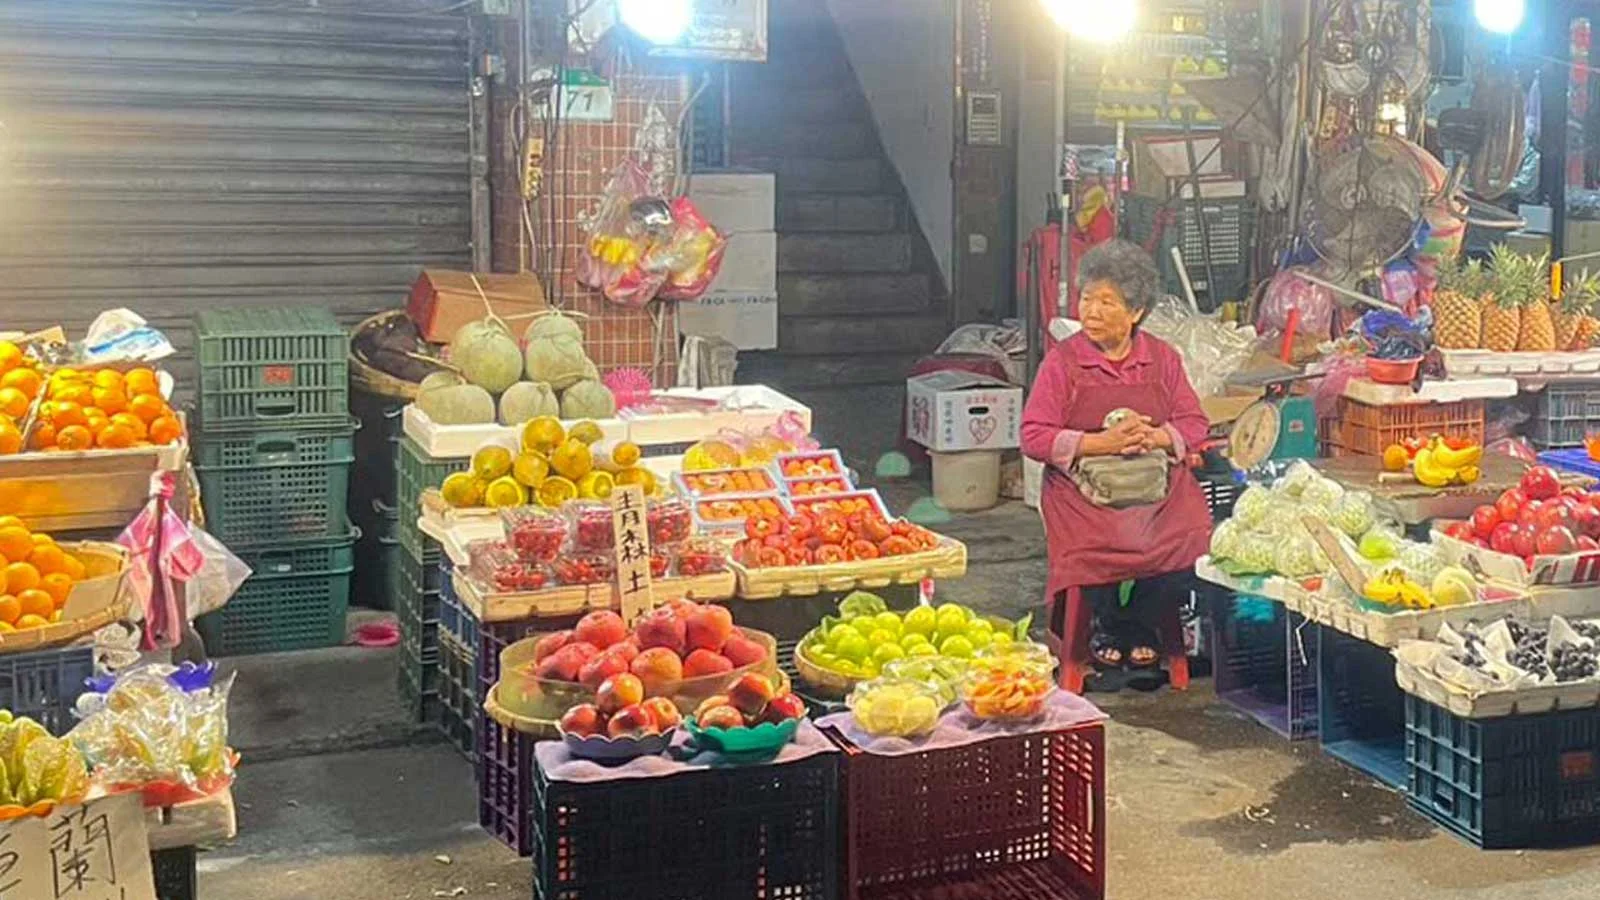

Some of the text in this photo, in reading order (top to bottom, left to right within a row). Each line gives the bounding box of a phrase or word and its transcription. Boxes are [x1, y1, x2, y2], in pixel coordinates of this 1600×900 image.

[615, 491, 649, 629] 青森土
[0, 802, 116, 899] 蘭
